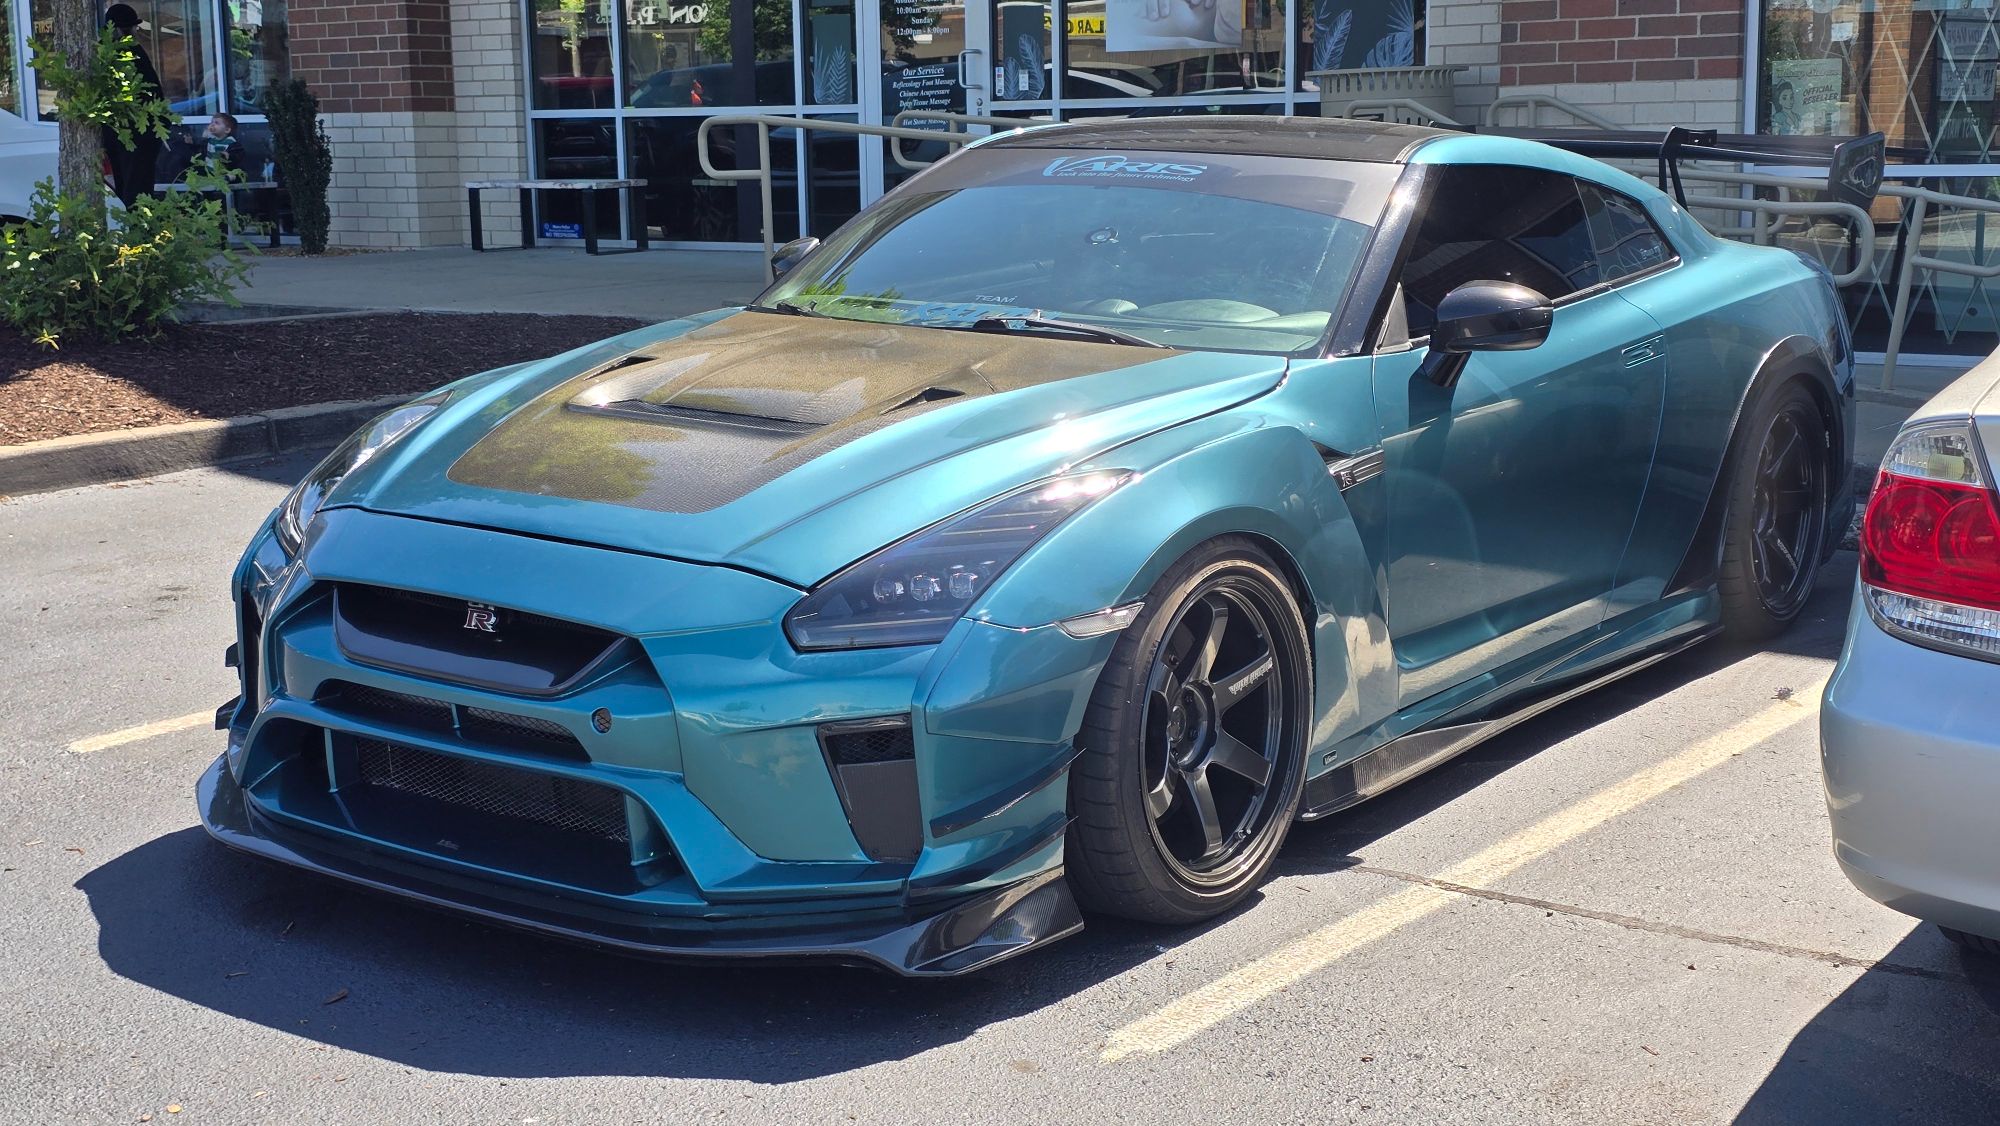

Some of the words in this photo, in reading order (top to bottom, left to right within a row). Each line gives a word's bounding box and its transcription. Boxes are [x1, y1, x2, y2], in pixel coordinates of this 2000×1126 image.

[911, 17, 934, 26] Sunday
[896, 27, 922, 36] 12:00pm
[903, 68, 915, 77] Our
[917, 66, 945, 76] Services
[899, 90, 919, 98] Chinese
[1043, 155, 1208, 177] VARIS
[1143, 173, 1196, 183] technology
